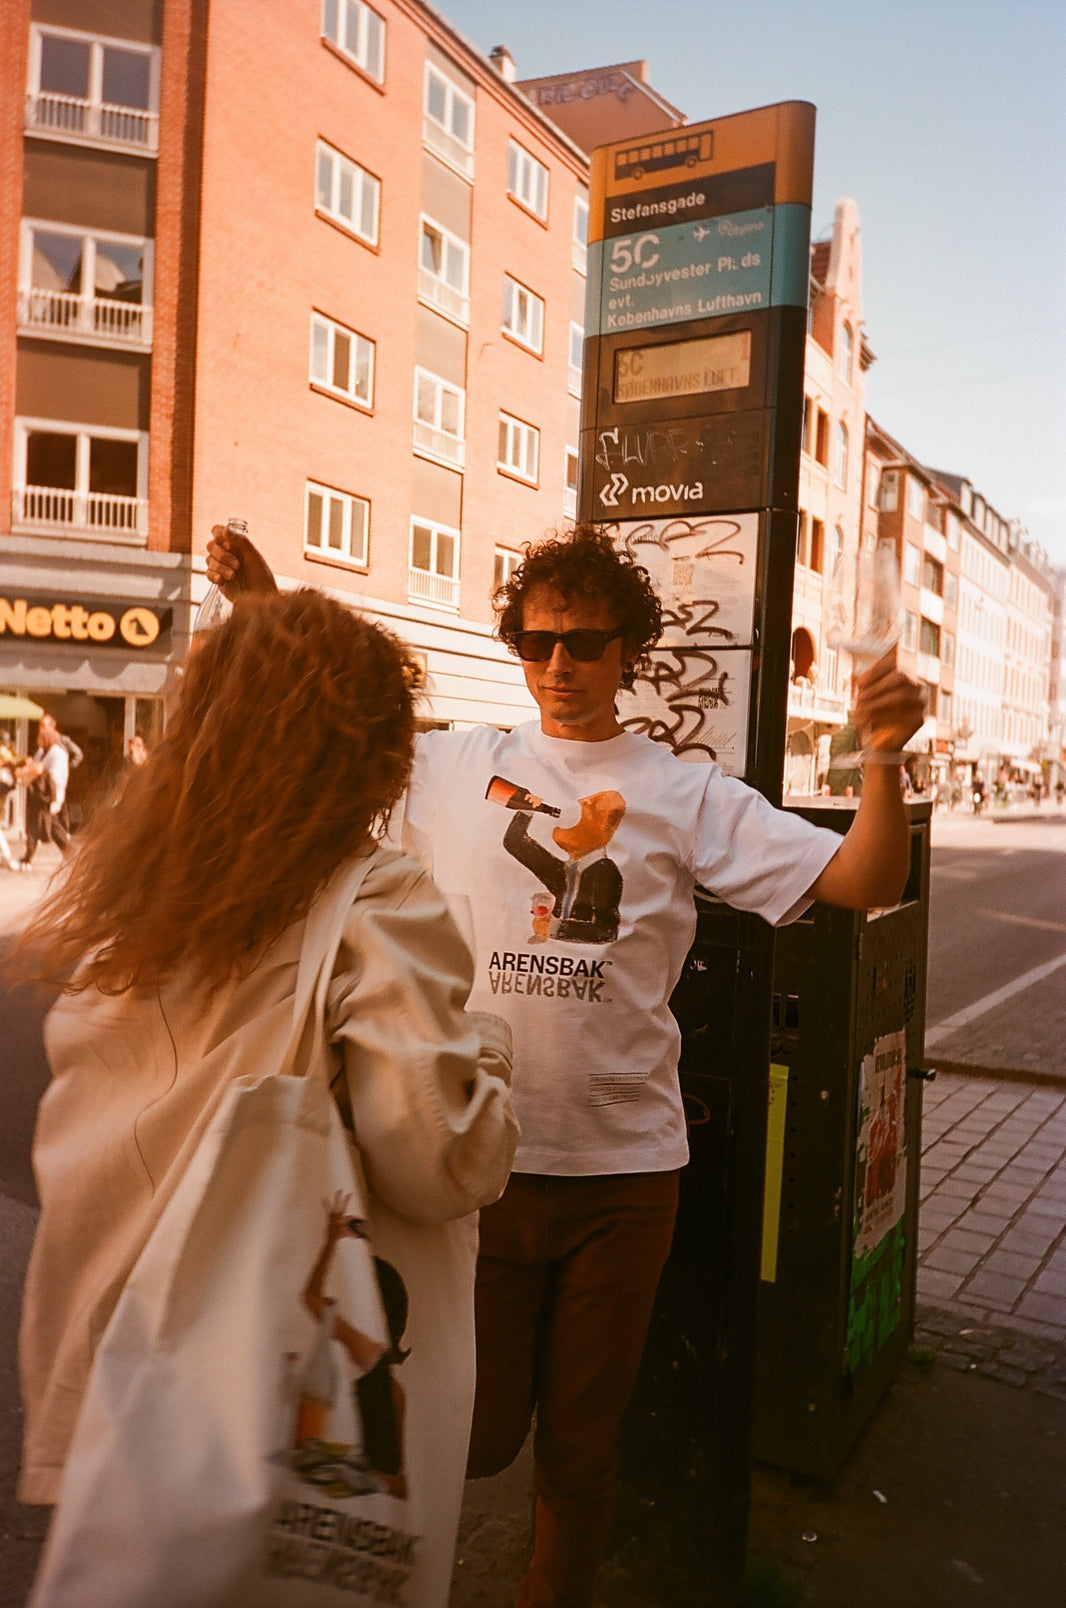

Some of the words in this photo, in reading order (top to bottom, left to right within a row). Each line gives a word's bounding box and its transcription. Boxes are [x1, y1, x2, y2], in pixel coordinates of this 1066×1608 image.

[611, 192, 705, 223] Stefansgade
[611, 233, 661, 274] 5C
[608, 295, 635, 310] evt.
[698, 291, 762, 313] Lufthavn
[632, 482, 703, 504] movia
[0, 598, 116, 641] Netto
